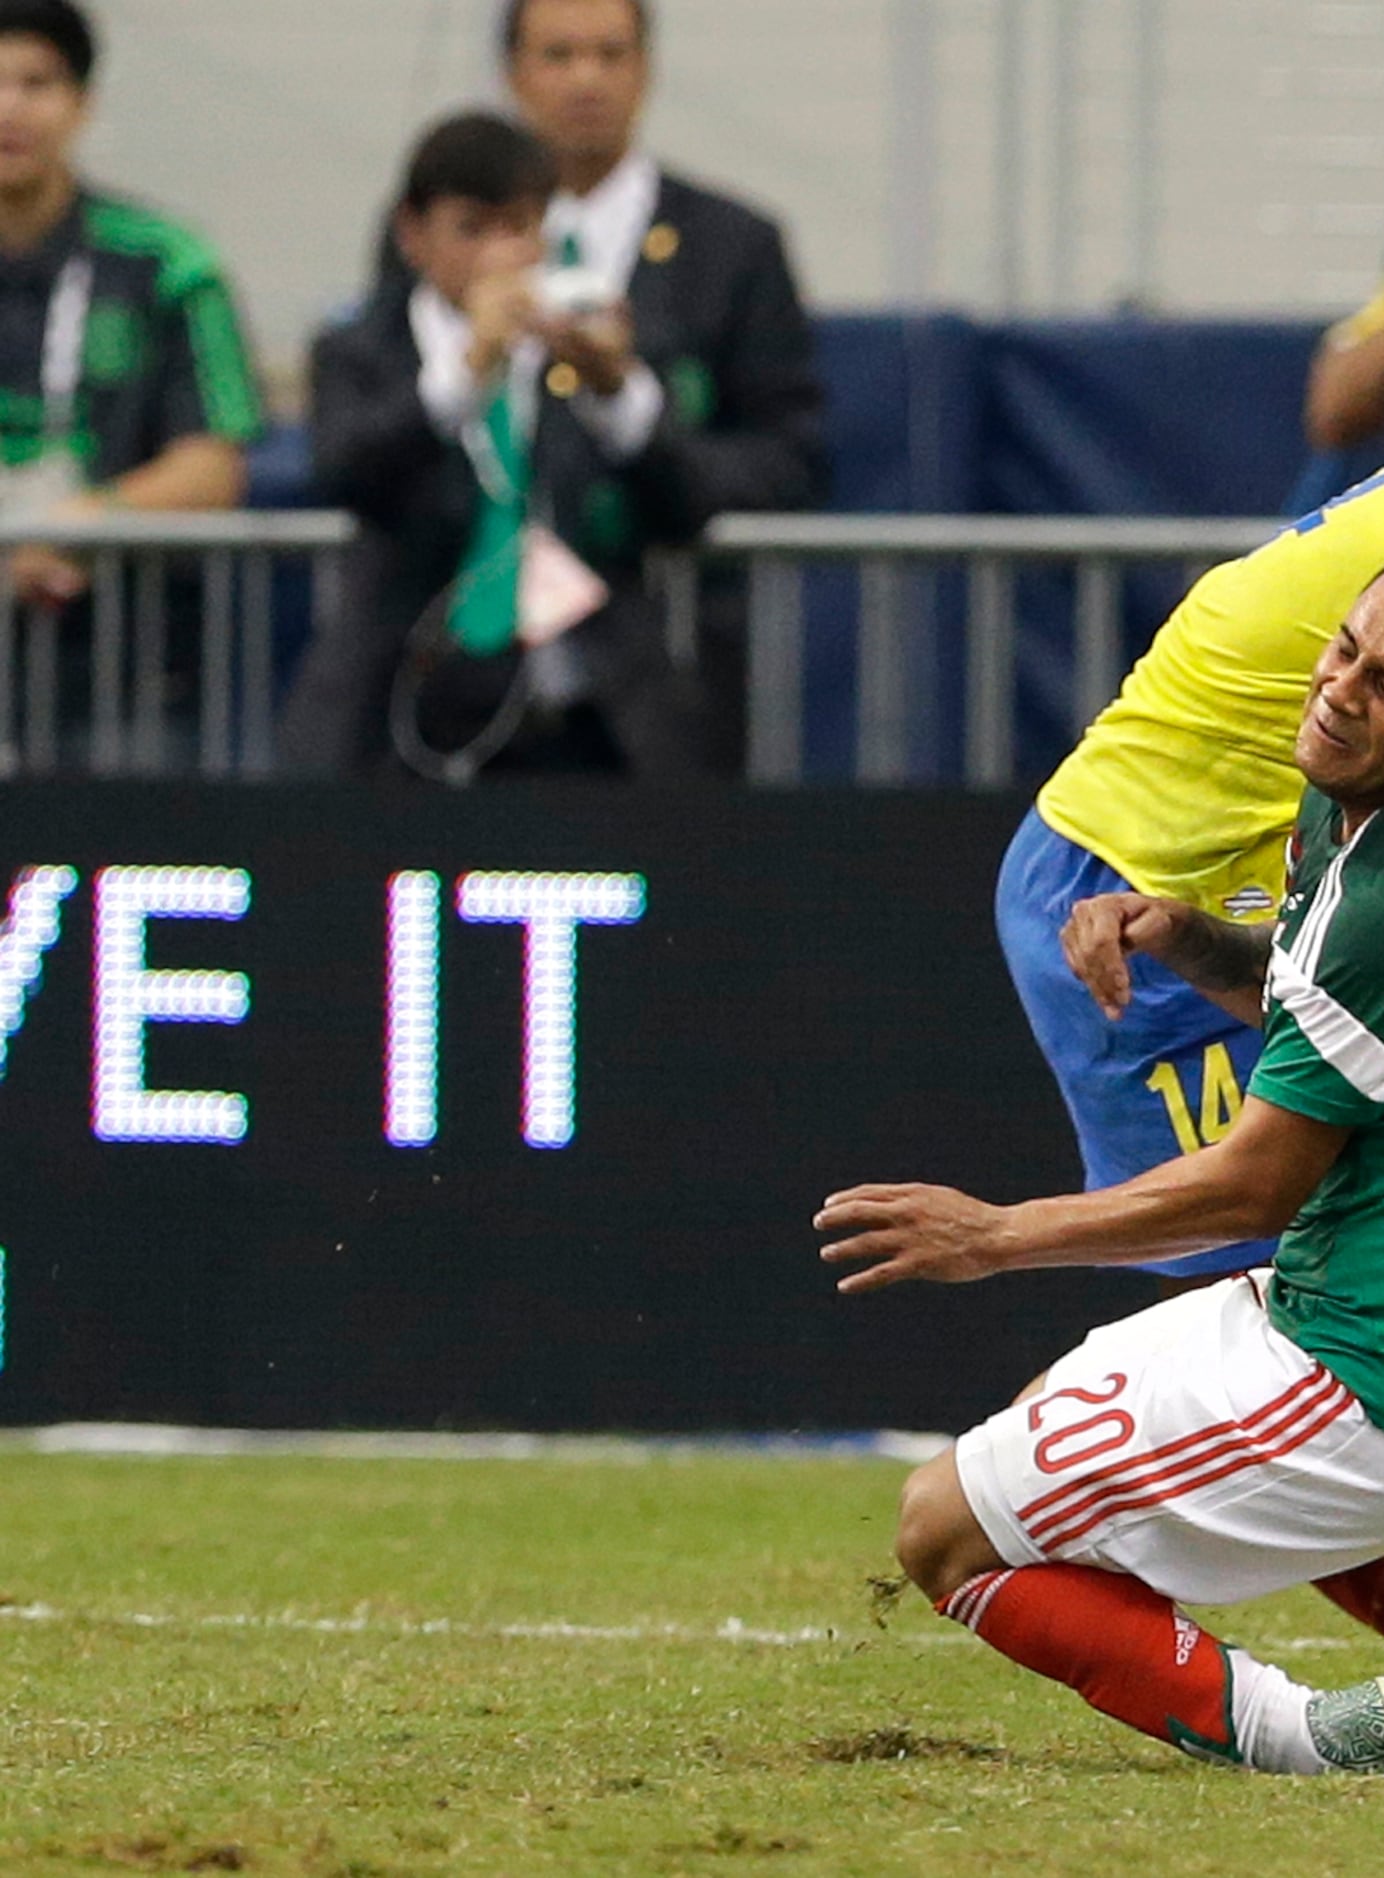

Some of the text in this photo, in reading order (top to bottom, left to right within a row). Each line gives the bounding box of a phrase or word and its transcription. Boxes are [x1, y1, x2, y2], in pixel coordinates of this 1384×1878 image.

[385, 869, 648, 1148] IT
[1145, 1042, 1244, 1156] 14
[1028, 1372, 1136, 1475] 20
